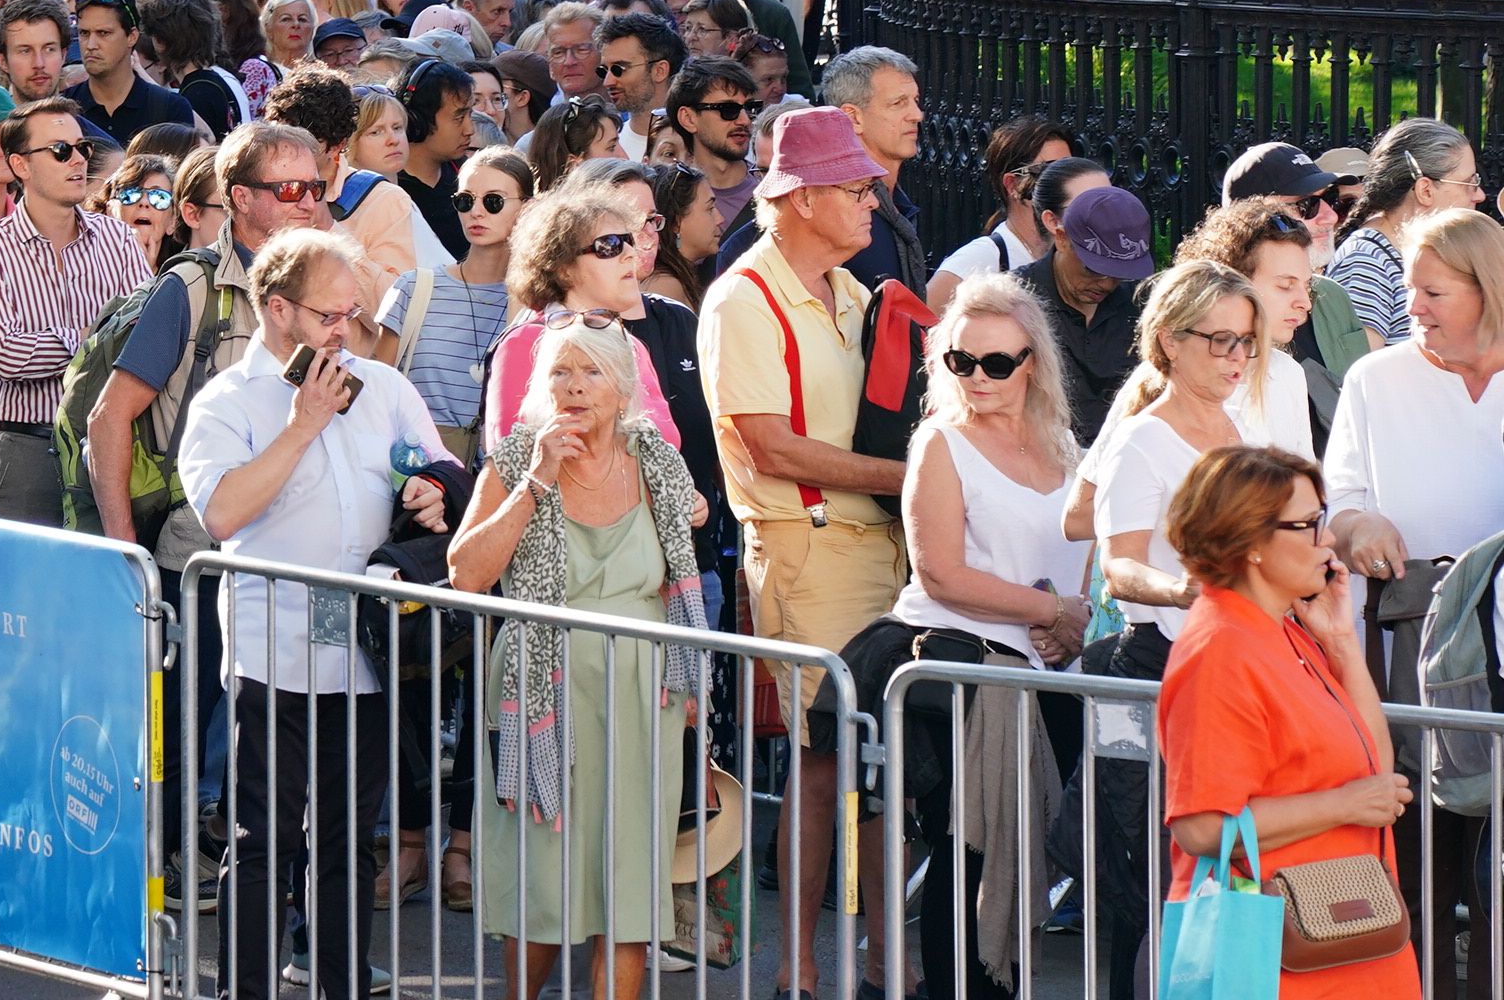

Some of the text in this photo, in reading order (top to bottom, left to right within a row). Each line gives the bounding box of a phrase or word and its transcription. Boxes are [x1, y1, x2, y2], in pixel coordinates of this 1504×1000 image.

[59, 746, 114, 795] ab 20.15 Uhr
[64, 771, 105, 808] auch auf
